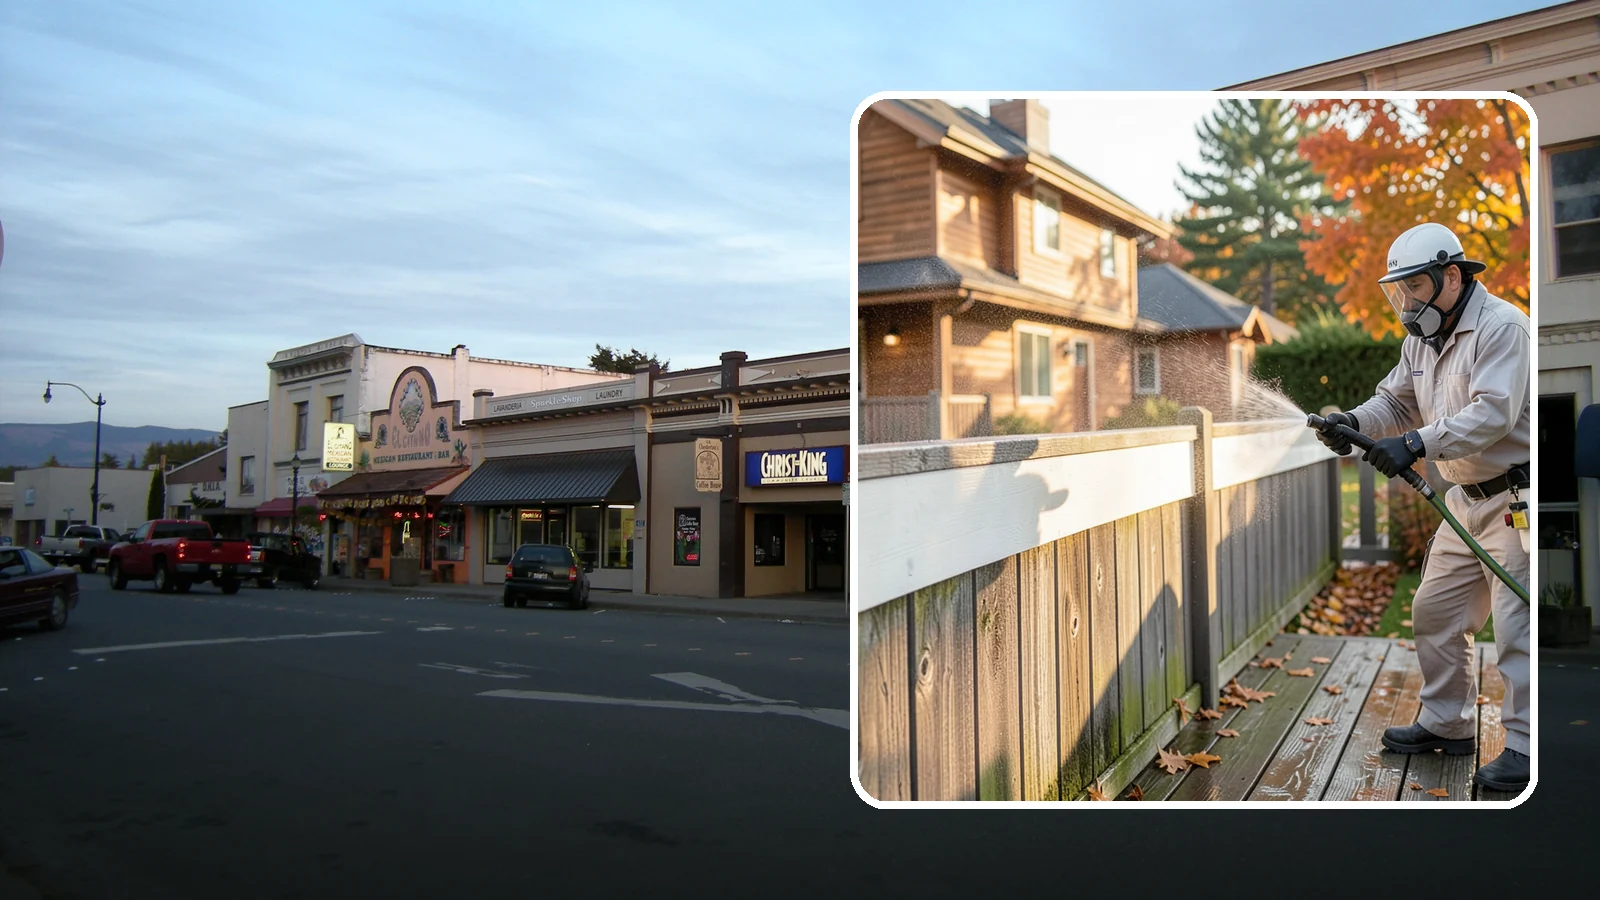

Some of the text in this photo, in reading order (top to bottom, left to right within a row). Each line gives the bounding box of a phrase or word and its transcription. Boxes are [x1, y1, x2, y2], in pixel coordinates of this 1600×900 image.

[595, 389, 624, 400] LAUNDRY
[493, 402, 523, 413] LAVANDERIA
[530, 395, 582, 409] Sparkle Shop
[373, 455, 396, 464] MEXICAN
[397, 451, 433, 463] RESTAURANT
[438, 450, 450, 459] BAR
[761, 450, 827, 478] CHRIST KING
